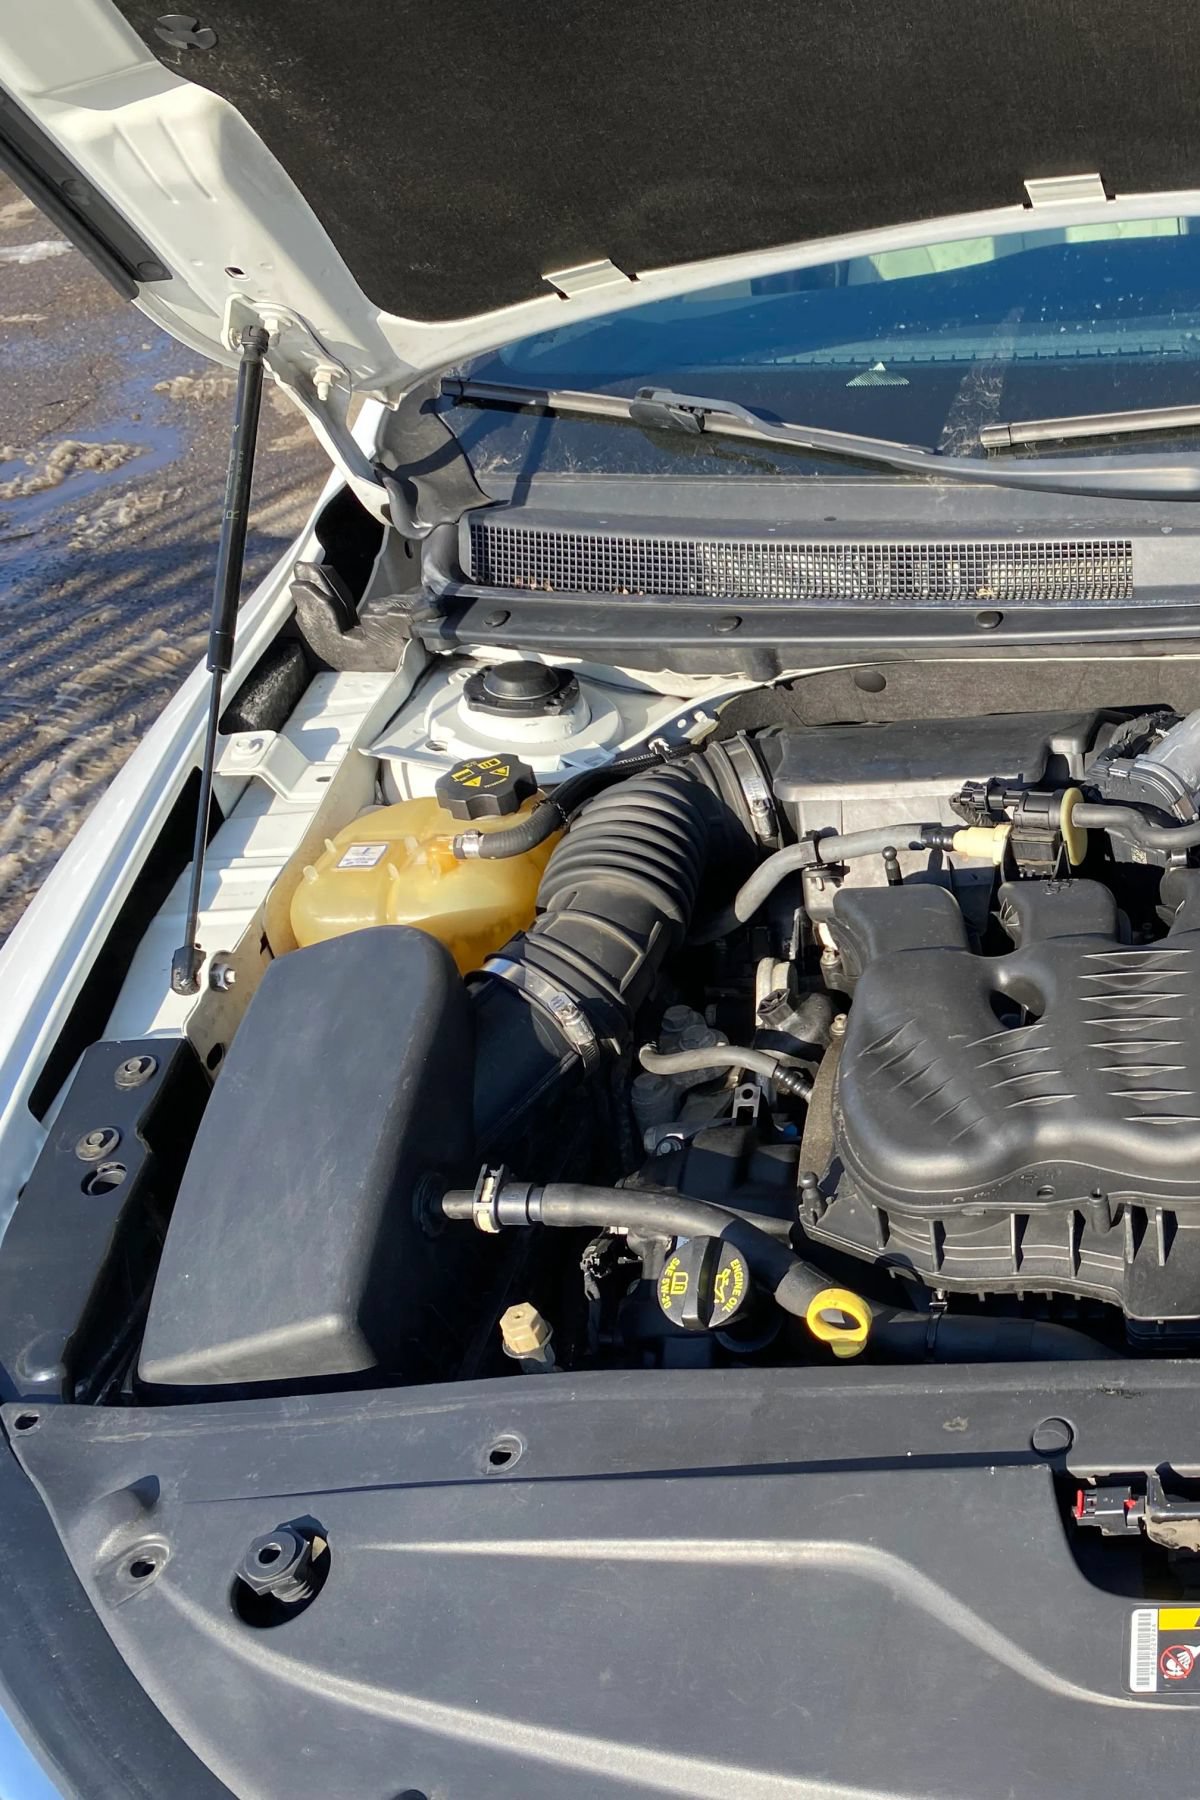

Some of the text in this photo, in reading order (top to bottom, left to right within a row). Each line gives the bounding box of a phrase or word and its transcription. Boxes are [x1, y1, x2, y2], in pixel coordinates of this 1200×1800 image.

[664, 1257, 680, 1277] SAE
[722, 1258, 744, 1313] ENGINE OIL
